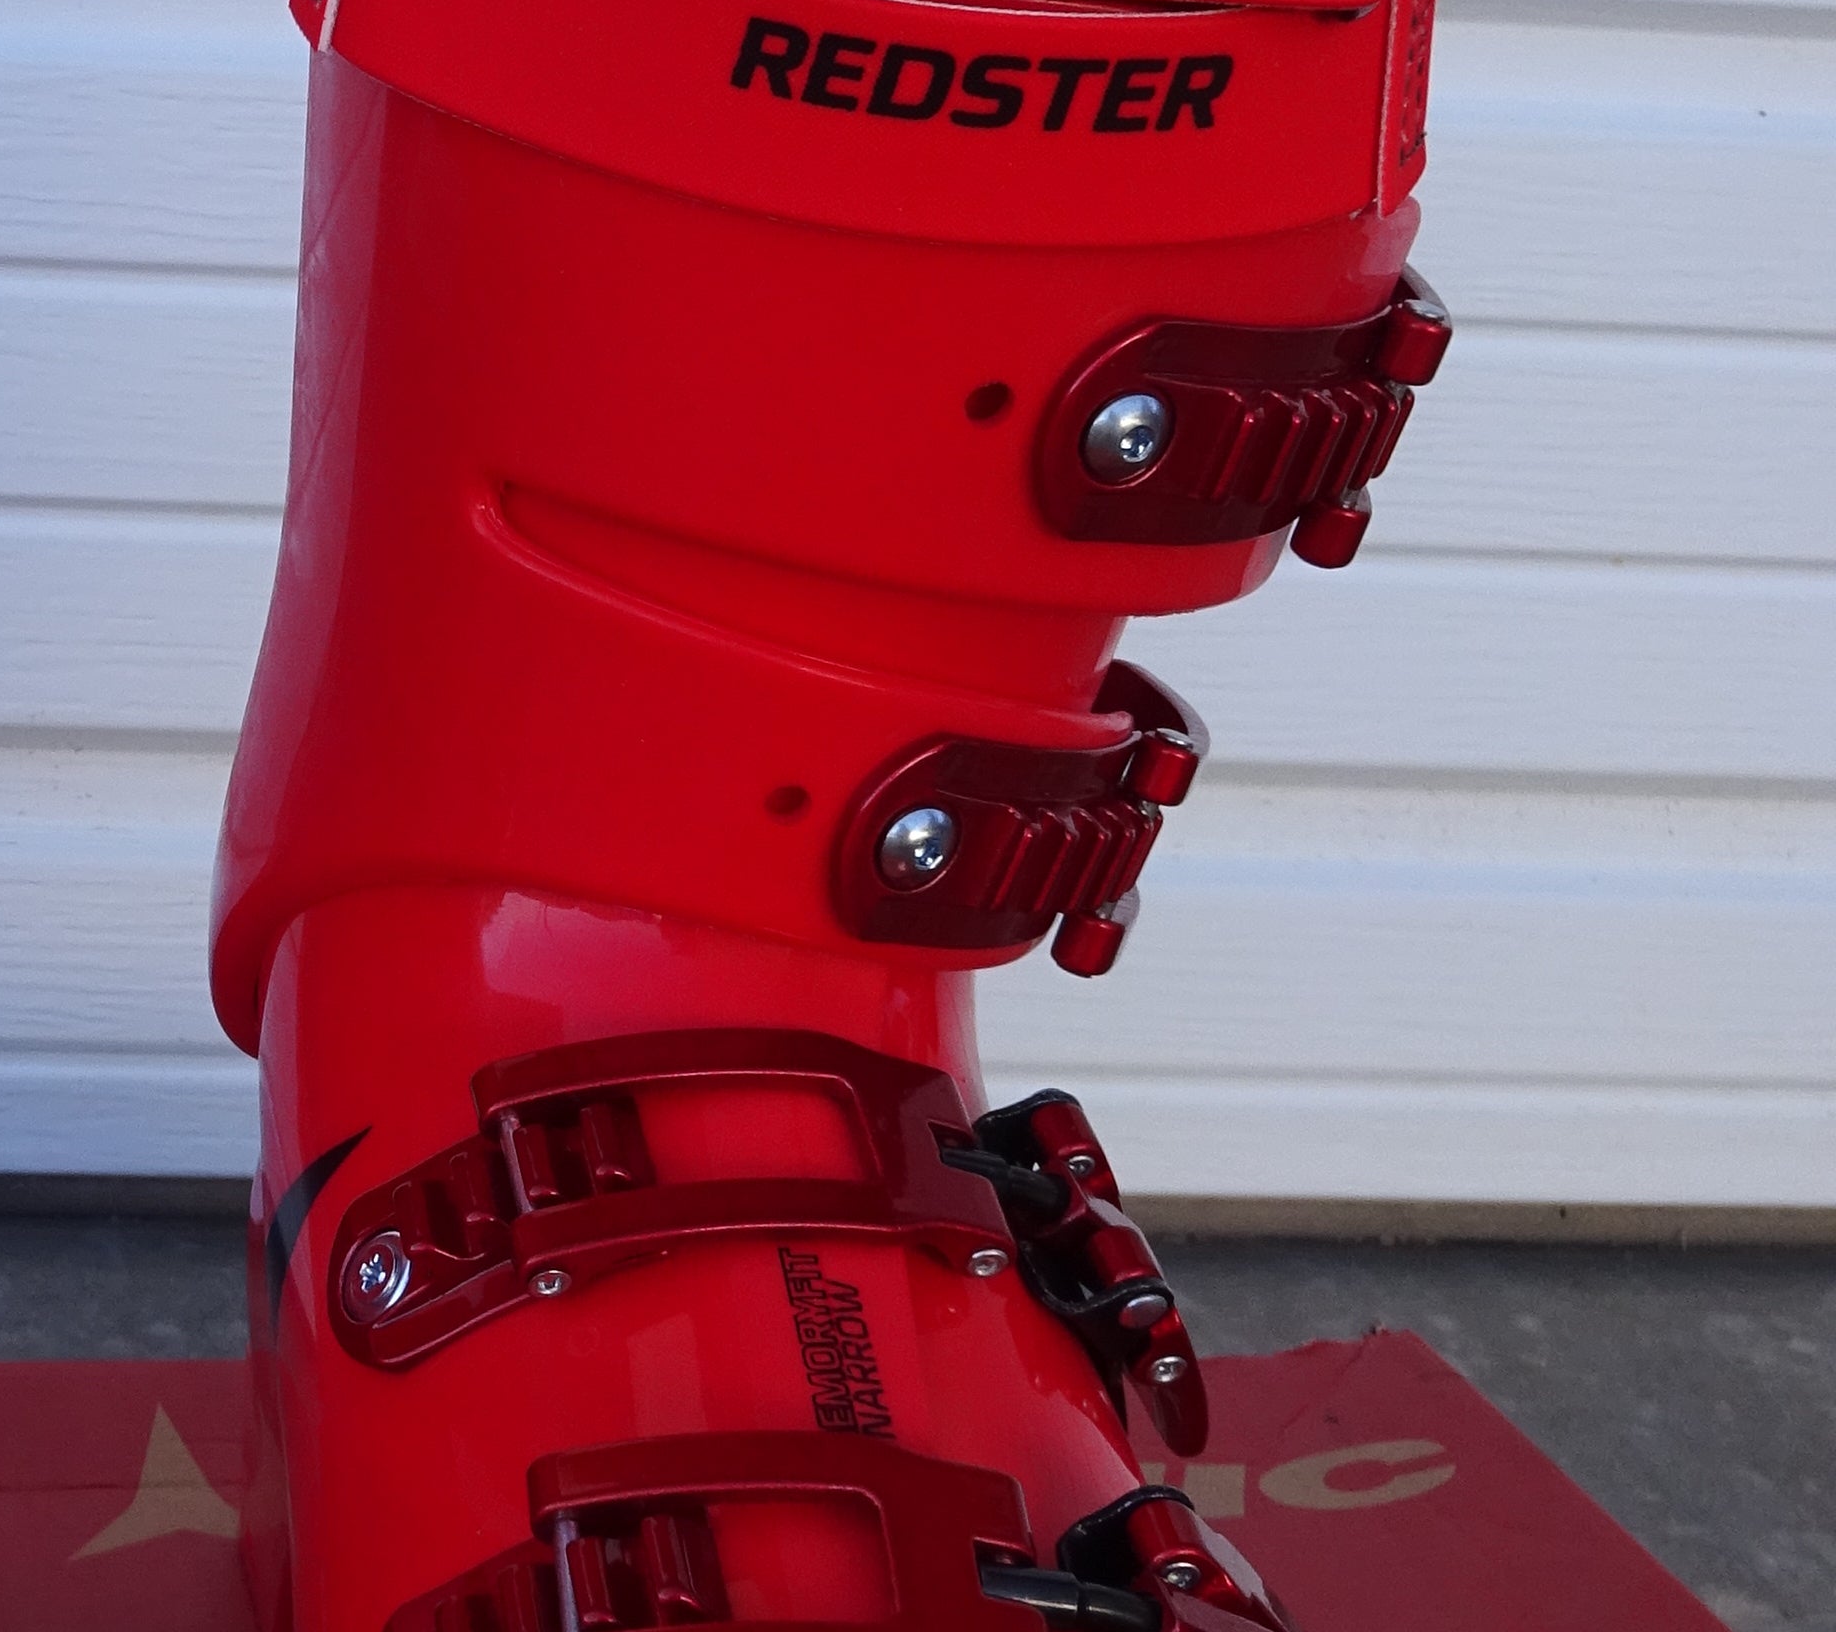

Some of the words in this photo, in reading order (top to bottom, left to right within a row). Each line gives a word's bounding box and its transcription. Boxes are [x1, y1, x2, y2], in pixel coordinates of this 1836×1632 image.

[730, 16, 1234, 134] REDSTER
[778, 1247, 860, 1433] EMORYFIT
[824, 1279, 897, 1439] NARROW
[1139, 1438, 1457, 1519] IC
